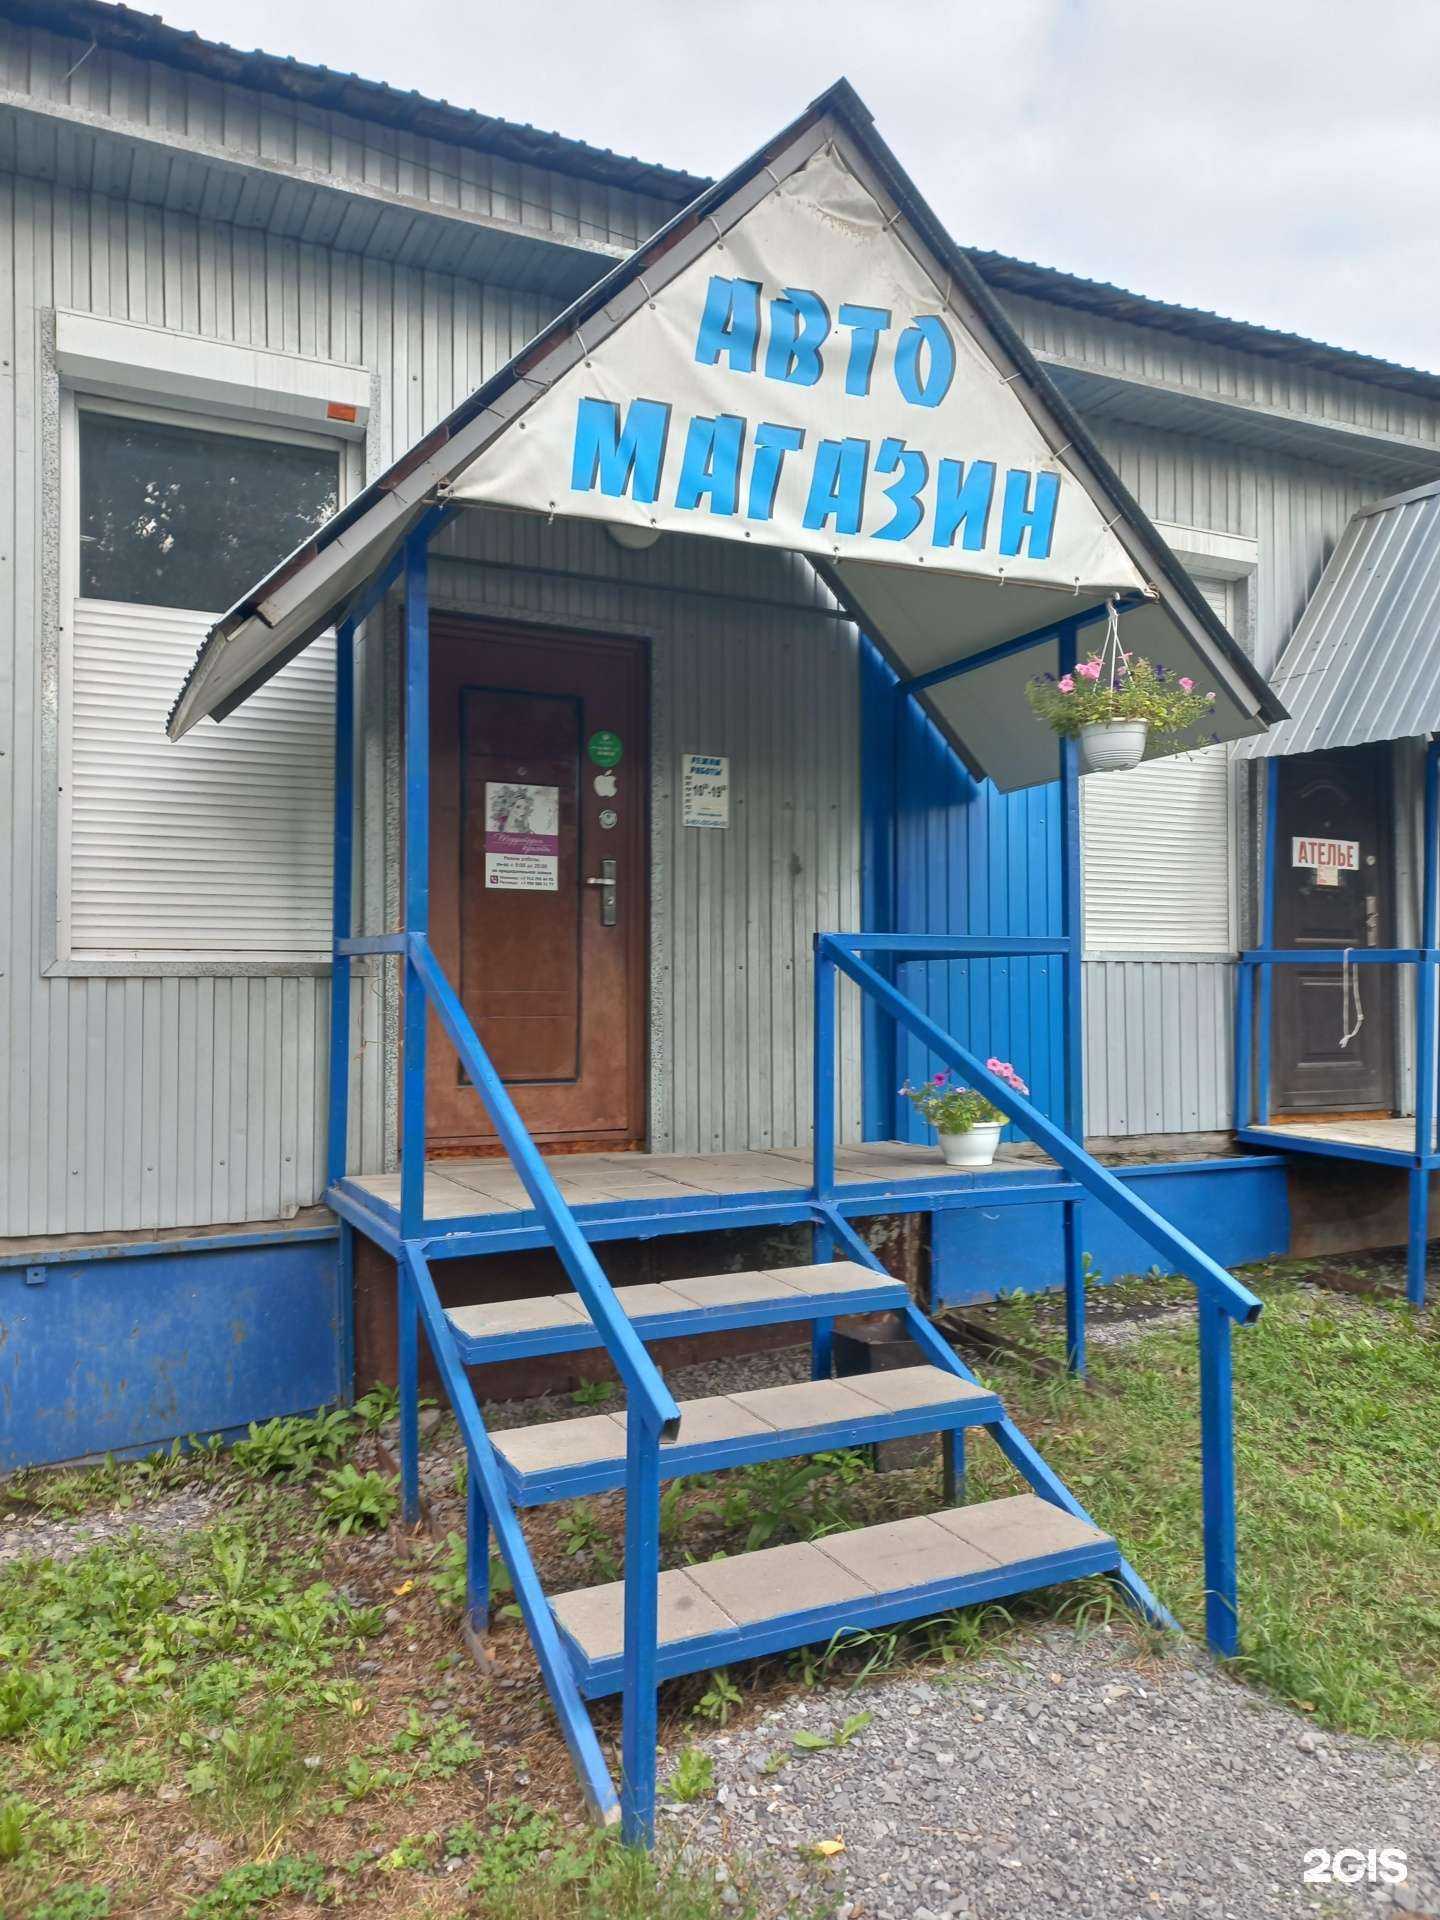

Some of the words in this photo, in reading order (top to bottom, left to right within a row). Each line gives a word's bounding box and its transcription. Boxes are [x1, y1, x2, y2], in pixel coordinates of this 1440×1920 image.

[694, 275, 956, 408] АВТО
[570, 397, 1061, 560] МАГАЗИН
[1298, 841, 1354, 868] АТЕЛЬЕ
